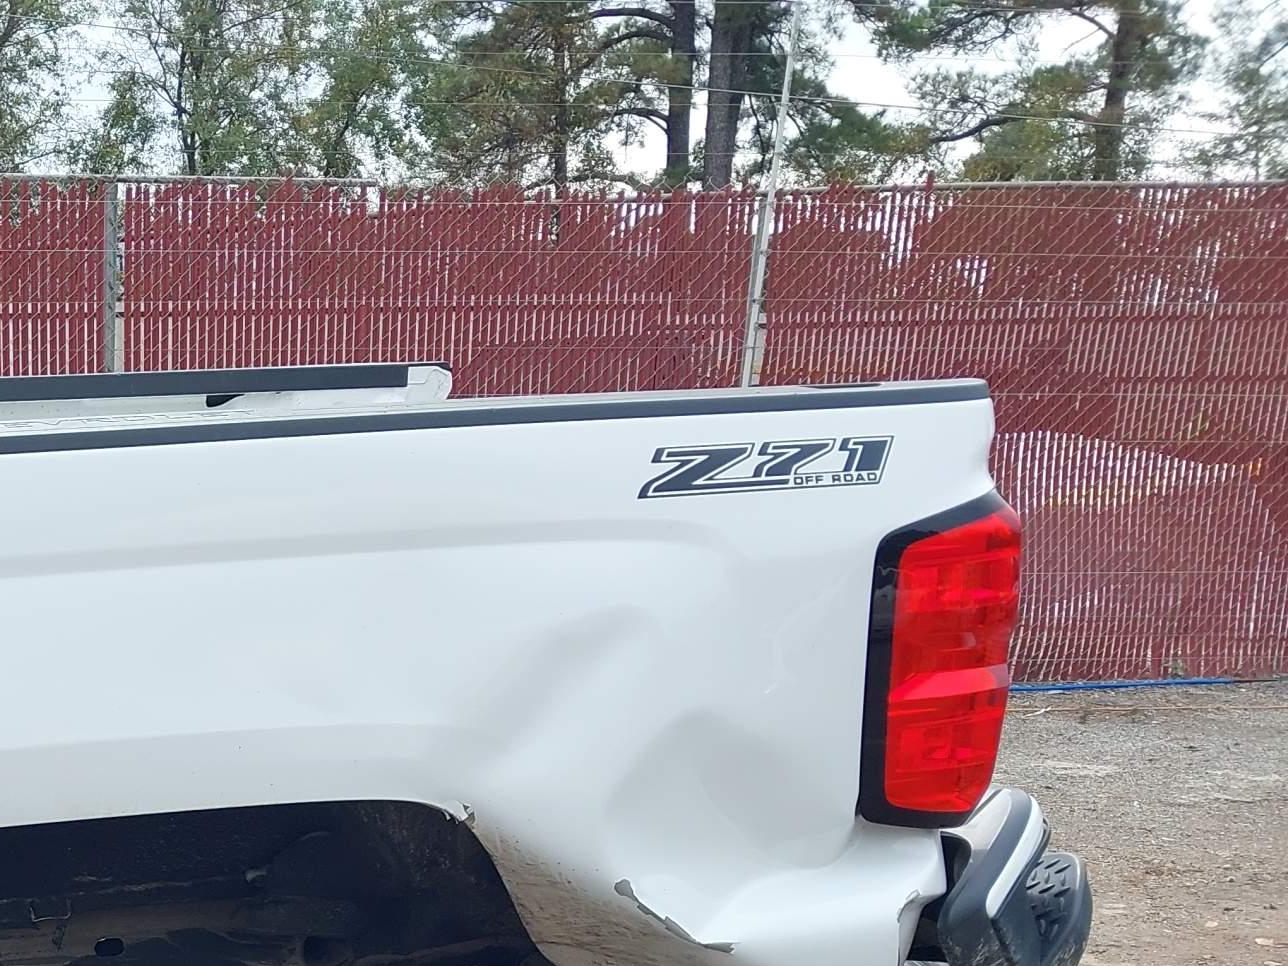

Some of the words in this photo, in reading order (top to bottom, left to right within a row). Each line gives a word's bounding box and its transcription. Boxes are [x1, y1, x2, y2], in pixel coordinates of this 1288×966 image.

[637, 435, 895, 499] Z71
[793, 475, 824, 486] OFF
[831, 472, 878, 484] ROAD
